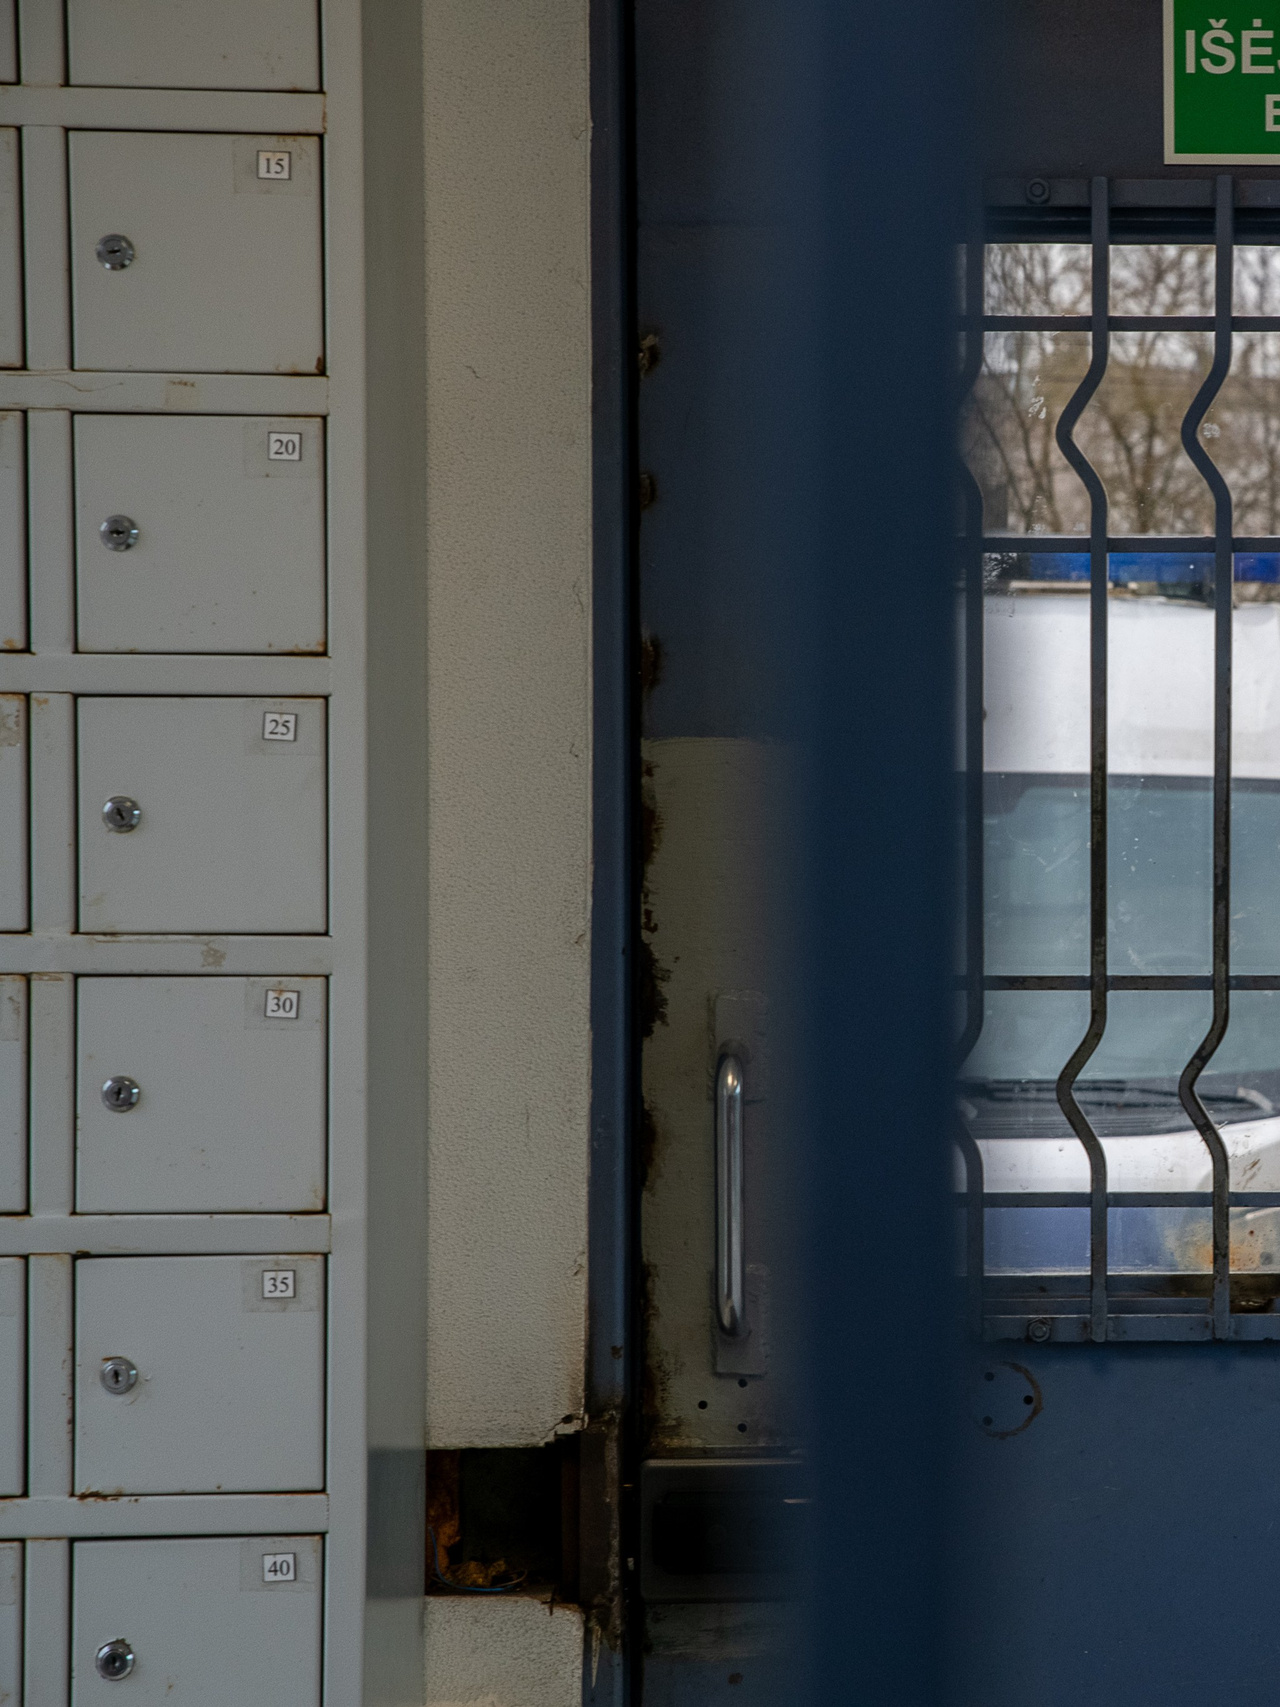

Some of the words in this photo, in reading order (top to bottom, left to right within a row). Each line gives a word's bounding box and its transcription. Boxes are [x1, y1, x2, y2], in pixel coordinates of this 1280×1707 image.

[264, 158, 284, 174] 15
[273, 439, 296, 455] 20
[269, 719, 290, 735] 25
[270, 997, 293, 1013] 30
[268, 1277, 289, 1293] 35
[268, 1560, 290, 1576] 40
